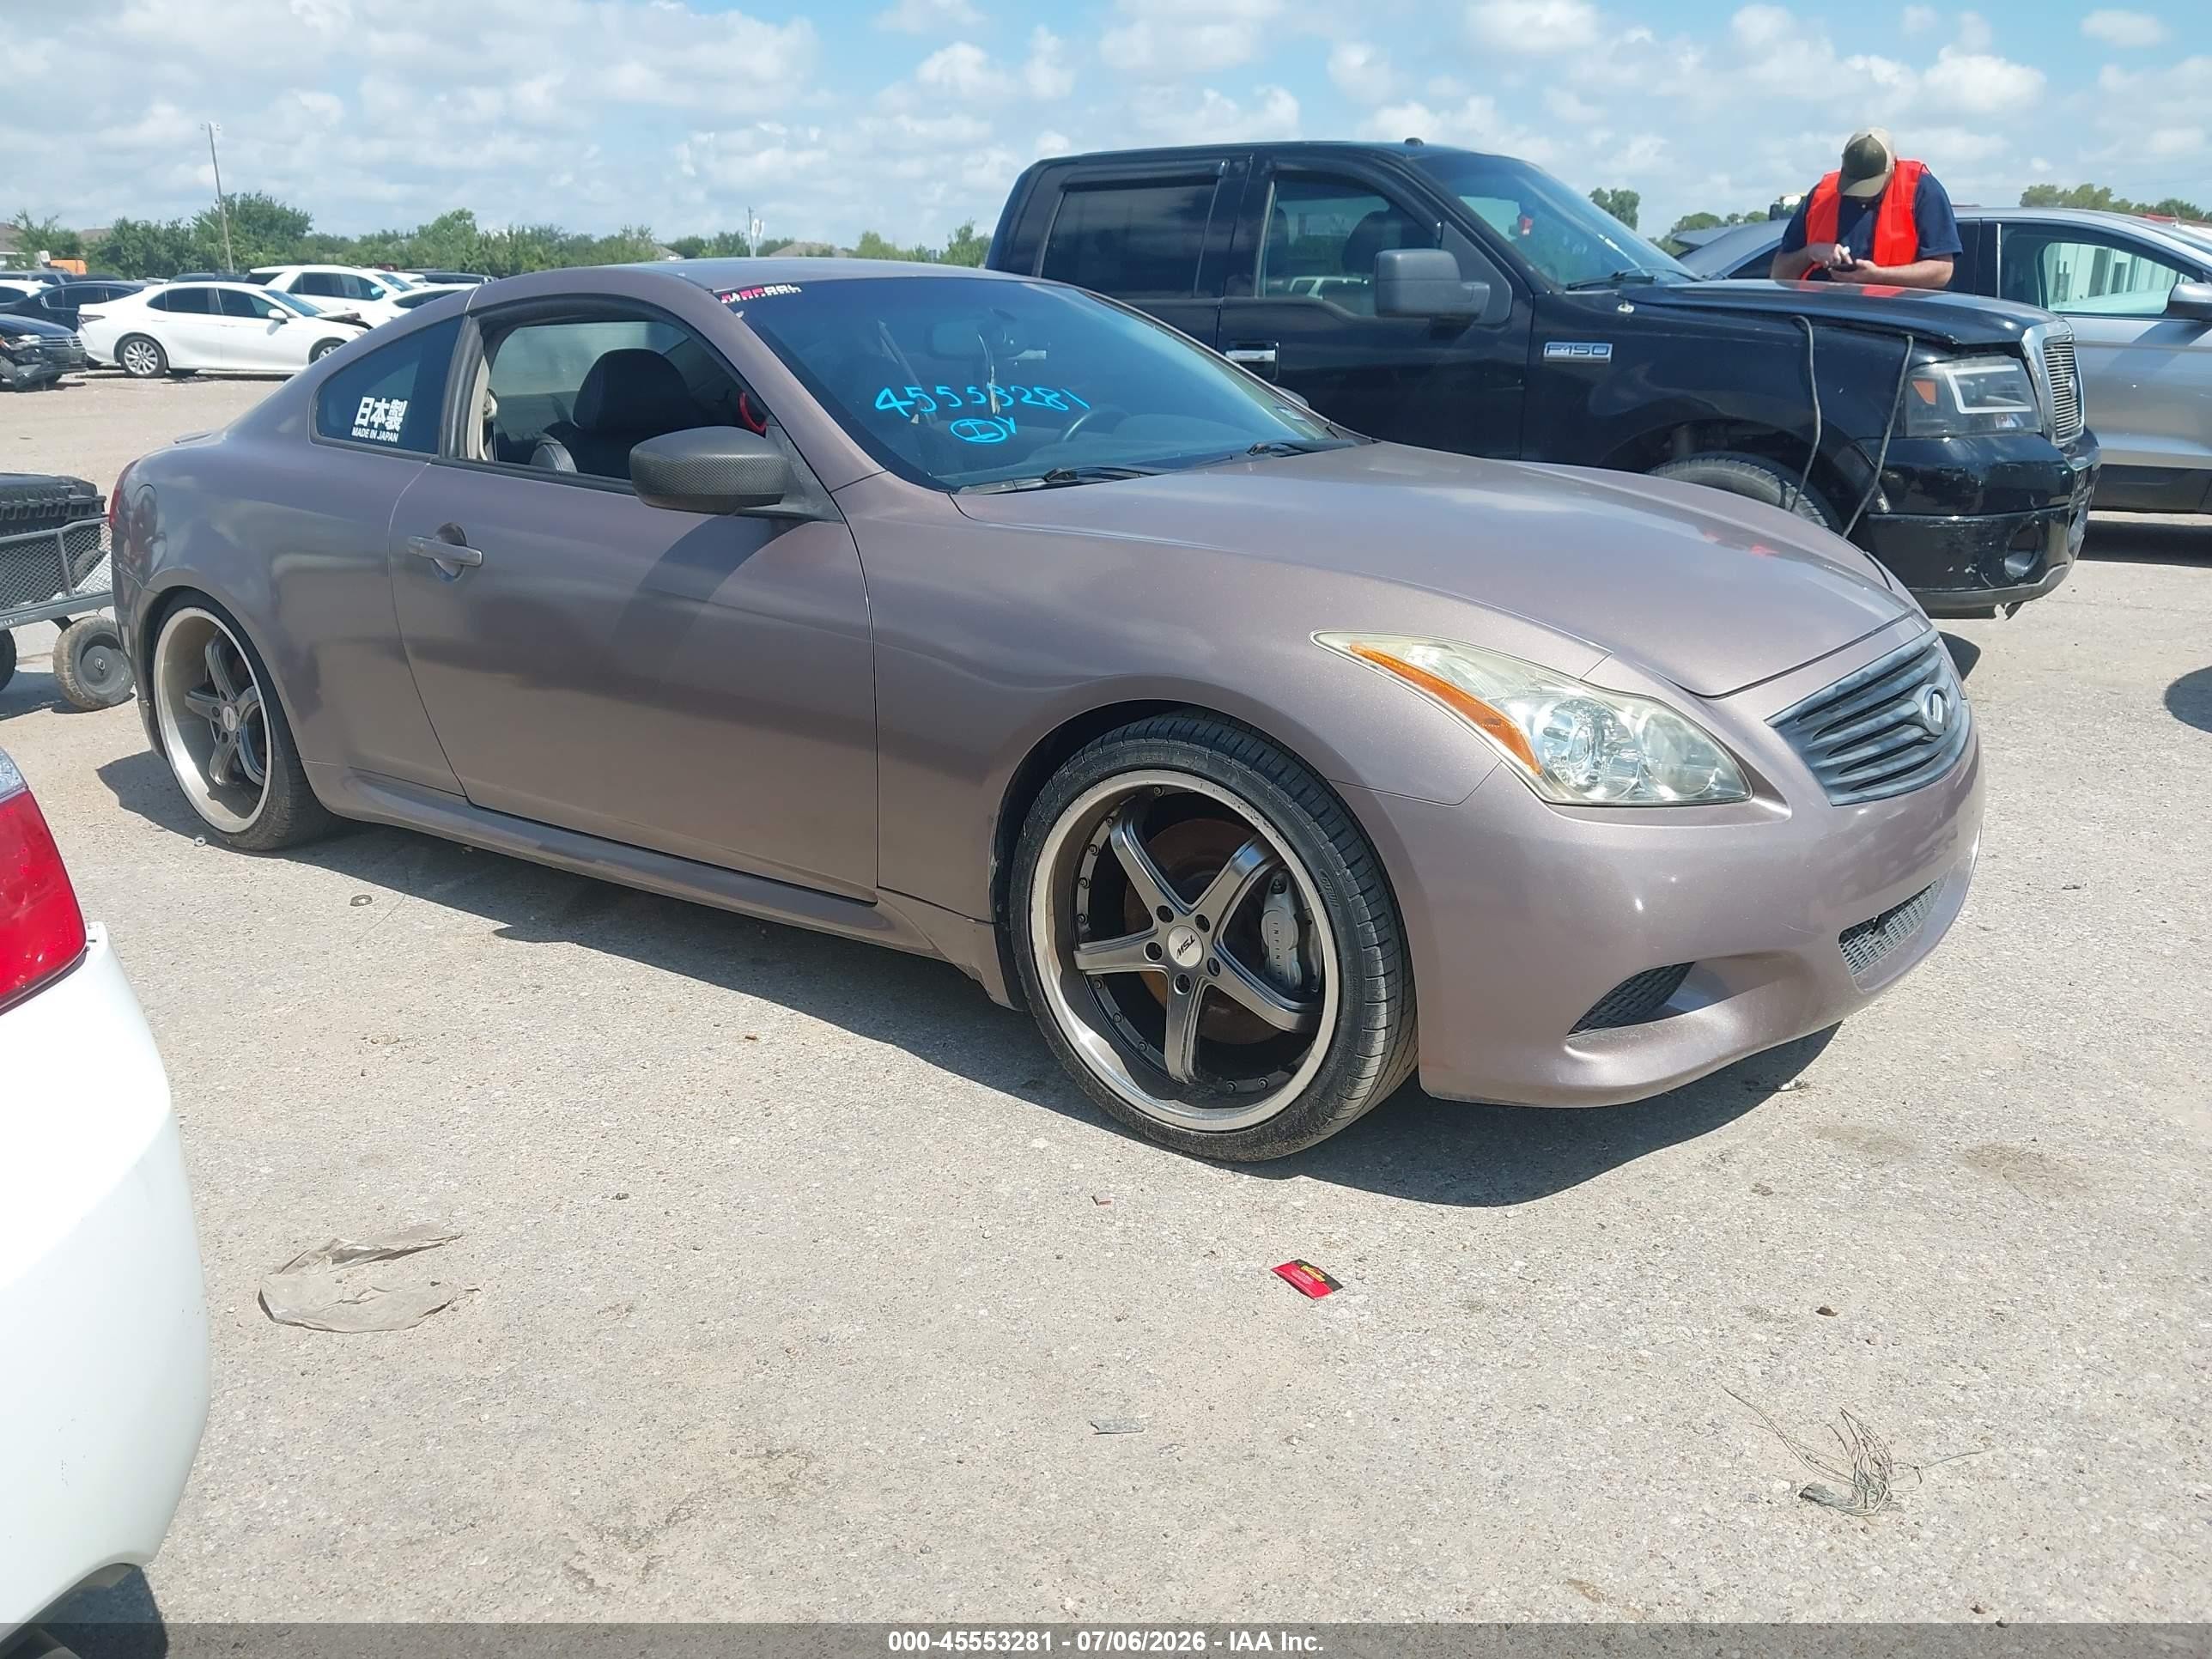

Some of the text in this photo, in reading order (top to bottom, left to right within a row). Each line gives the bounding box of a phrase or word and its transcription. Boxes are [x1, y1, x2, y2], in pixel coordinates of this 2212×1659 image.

[354, 396, 408, 432] 日本製
[875, 385, 1091, 418] 45553281
[351, 426, 399, 443] MADE IN JAPAN
[1176, 934, 1196, 958] TSW
